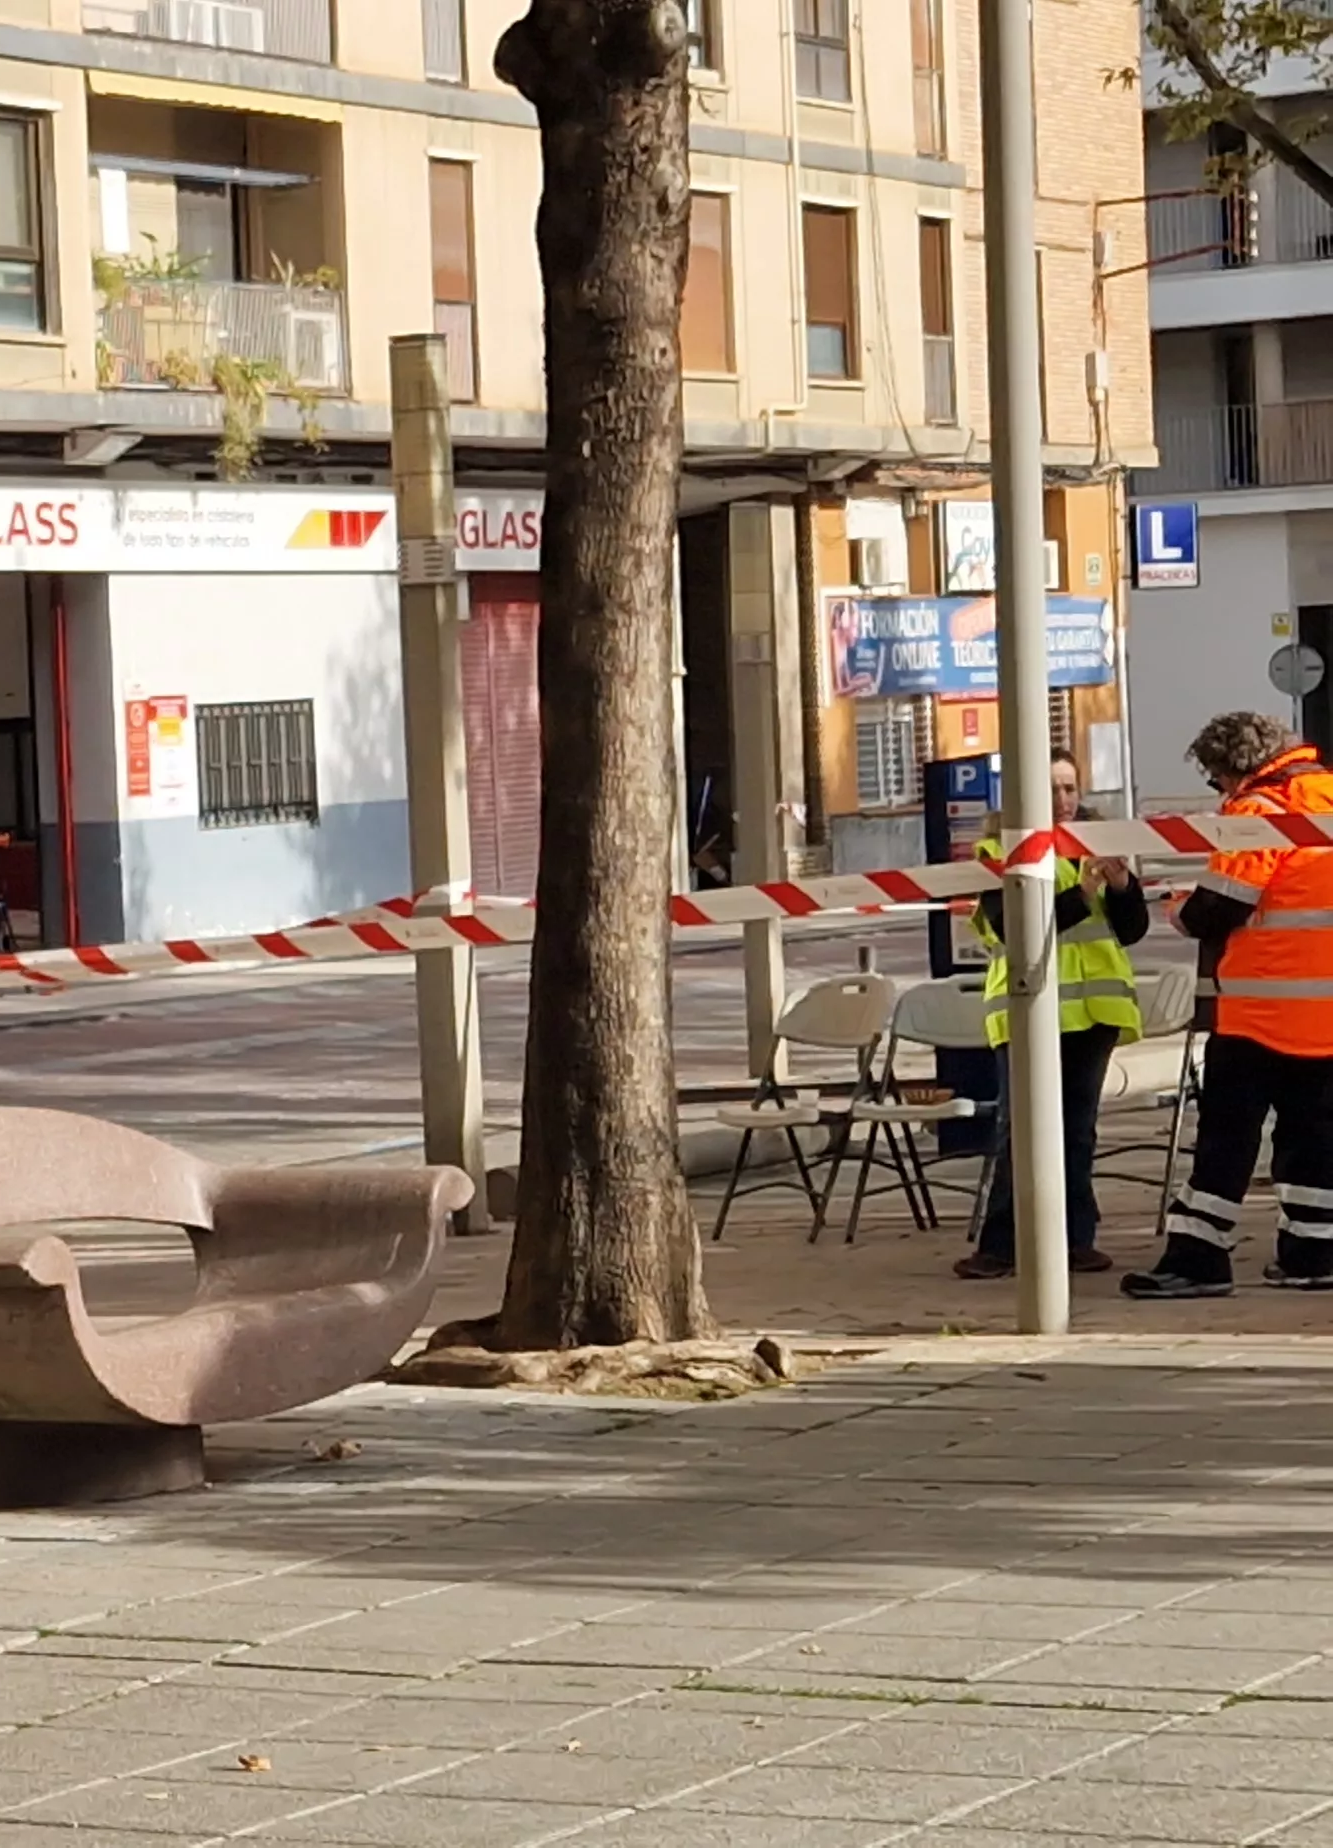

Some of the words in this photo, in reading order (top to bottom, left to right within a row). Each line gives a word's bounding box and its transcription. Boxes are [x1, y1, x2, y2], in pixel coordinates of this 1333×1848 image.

[454, 509, 539, 550] GLAS
[1151, 511, 1183, 559] L
[892, 641, 943, 671] ONLINE
[950, 637, 998, 668] TEÓRIC
[955, 765, 977, 792] P
